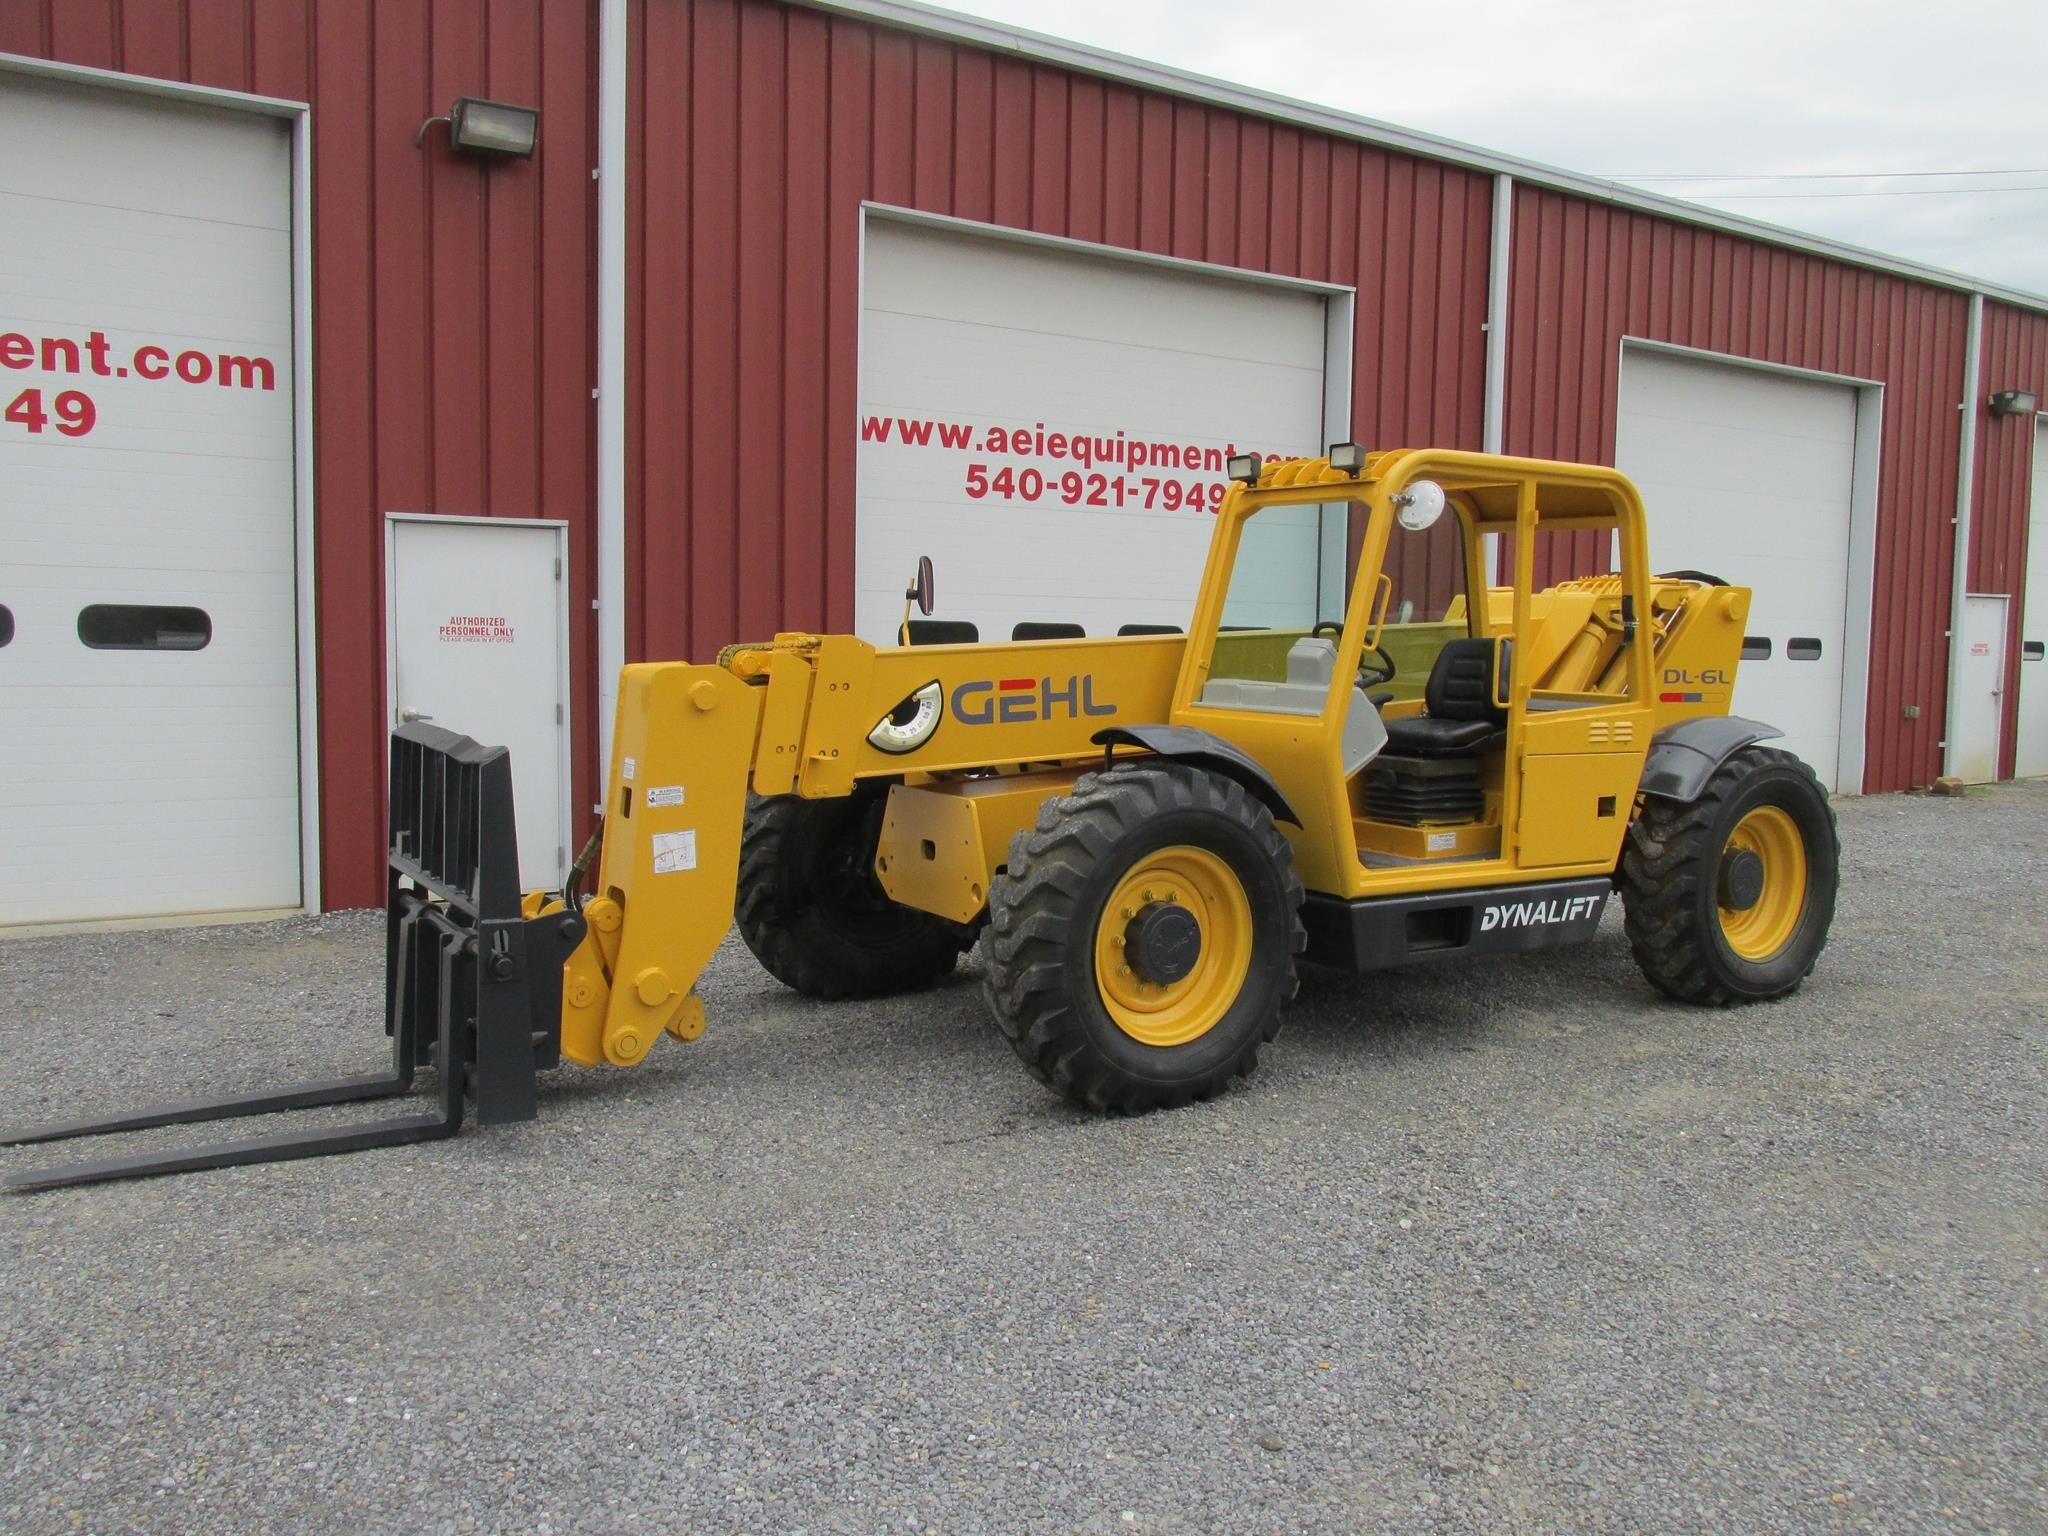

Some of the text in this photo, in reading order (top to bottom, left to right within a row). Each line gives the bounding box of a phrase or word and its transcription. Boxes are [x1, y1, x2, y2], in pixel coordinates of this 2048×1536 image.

[0, 331, 275, 390] ent.com
[5, 388, 97, 437] 49
[861, 415, 1308, 473] www.aeiequipment
[965, 464, 1227, 514] 540-921-7949
[440, 626, 514, 637] PERSONNEL ONLY
[450, 616, 505, 627] AUTHORIZED
[951, 674, 1117, 725] GEHL
[1663, 669, 1730, 685] DL-6L
[1480, 896, 1600, 931] DYNALIFT
